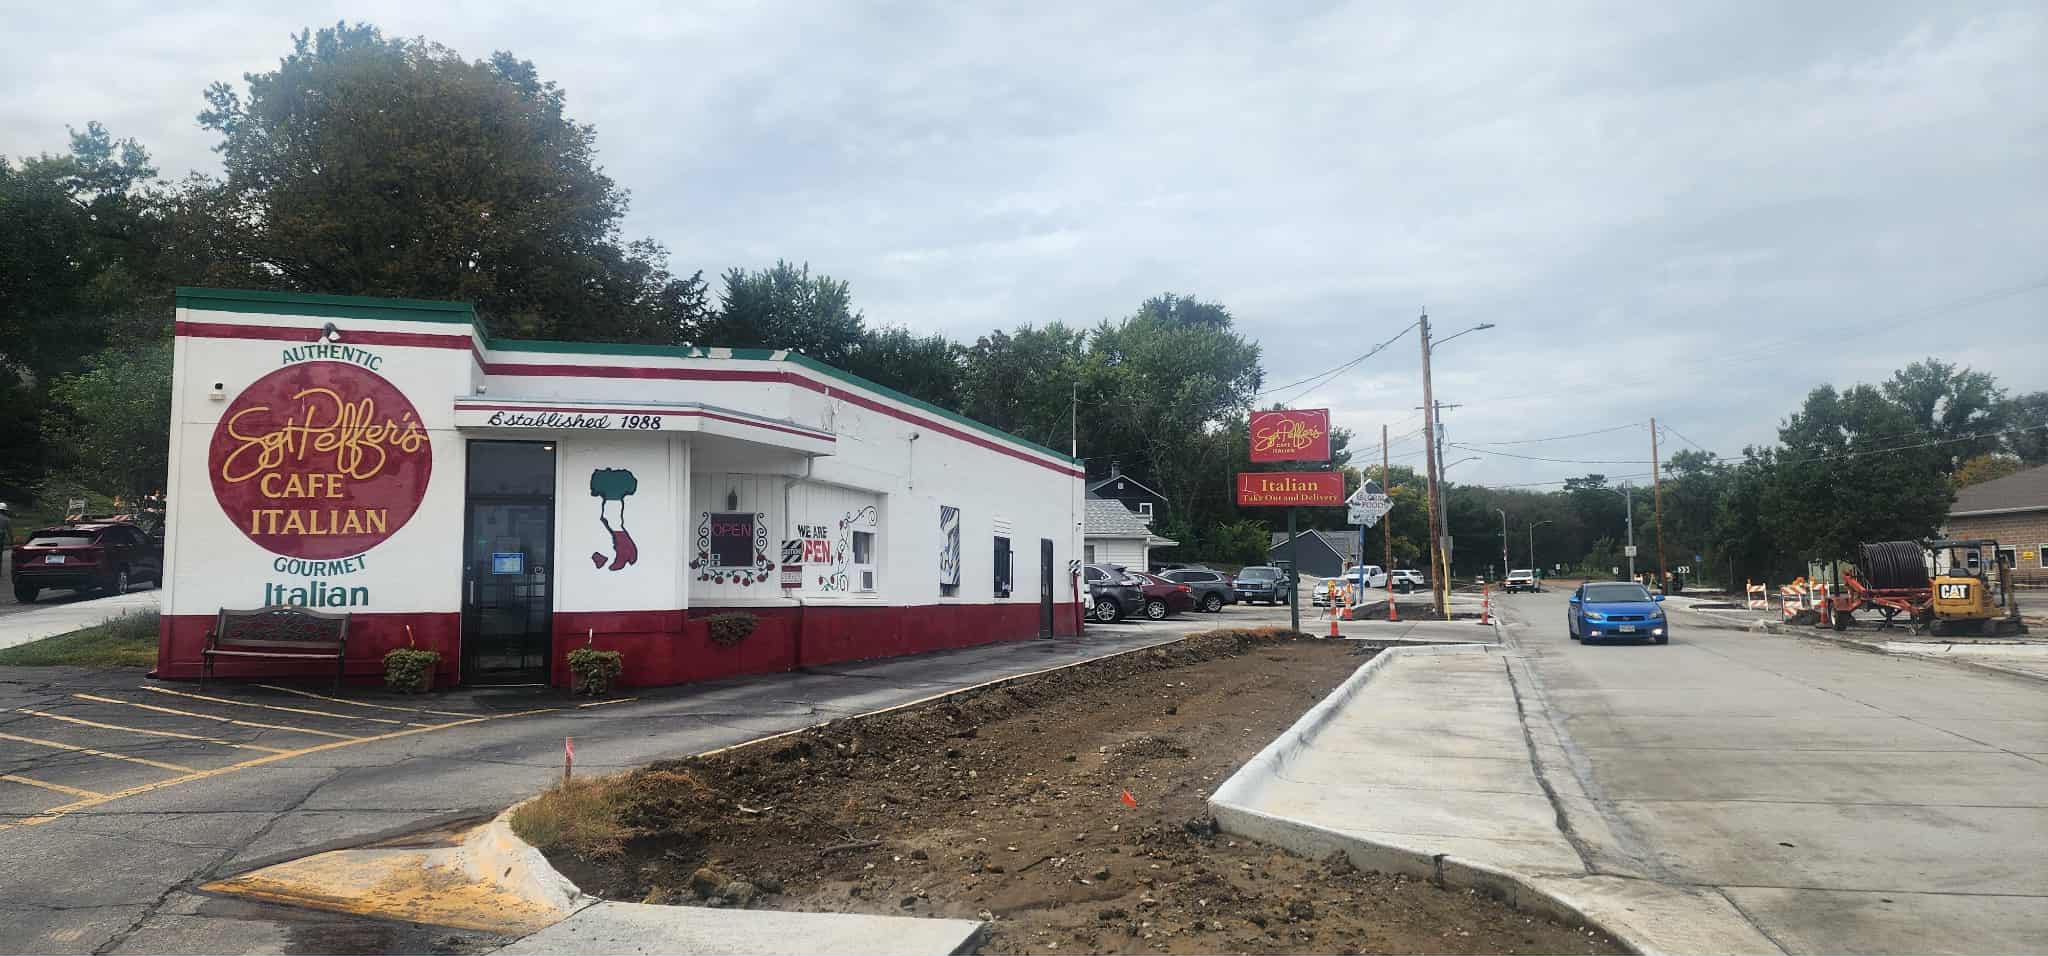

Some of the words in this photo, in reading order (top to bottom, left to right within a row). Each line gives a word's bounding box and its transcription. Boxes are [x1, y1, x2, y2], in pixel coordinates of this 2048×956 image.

[282, 343, 383, 372] AUTHENTIC
[487, 411, 611, 429] Established
[621, 415, 662, 430] 1988
[259, 472, 346, 499] CAFE
[1262, 477, 1318, 492] Italian
[1242, 494, 1264, 502] Take
[1265, 494, 1282, 502] Out
[250, 508, 388, 535] ITALIAN
[712, 522, 752, 537] OPEN
[798, 524, 811, 538] WE
[812, 526, 828, 539] ARE
[801, 540, 831, 563] PEN
[273, 554, 367, 577] GOURMET
[264, 580, 370, 608] Italian
[1940, 584, 1968, 599] CAT
